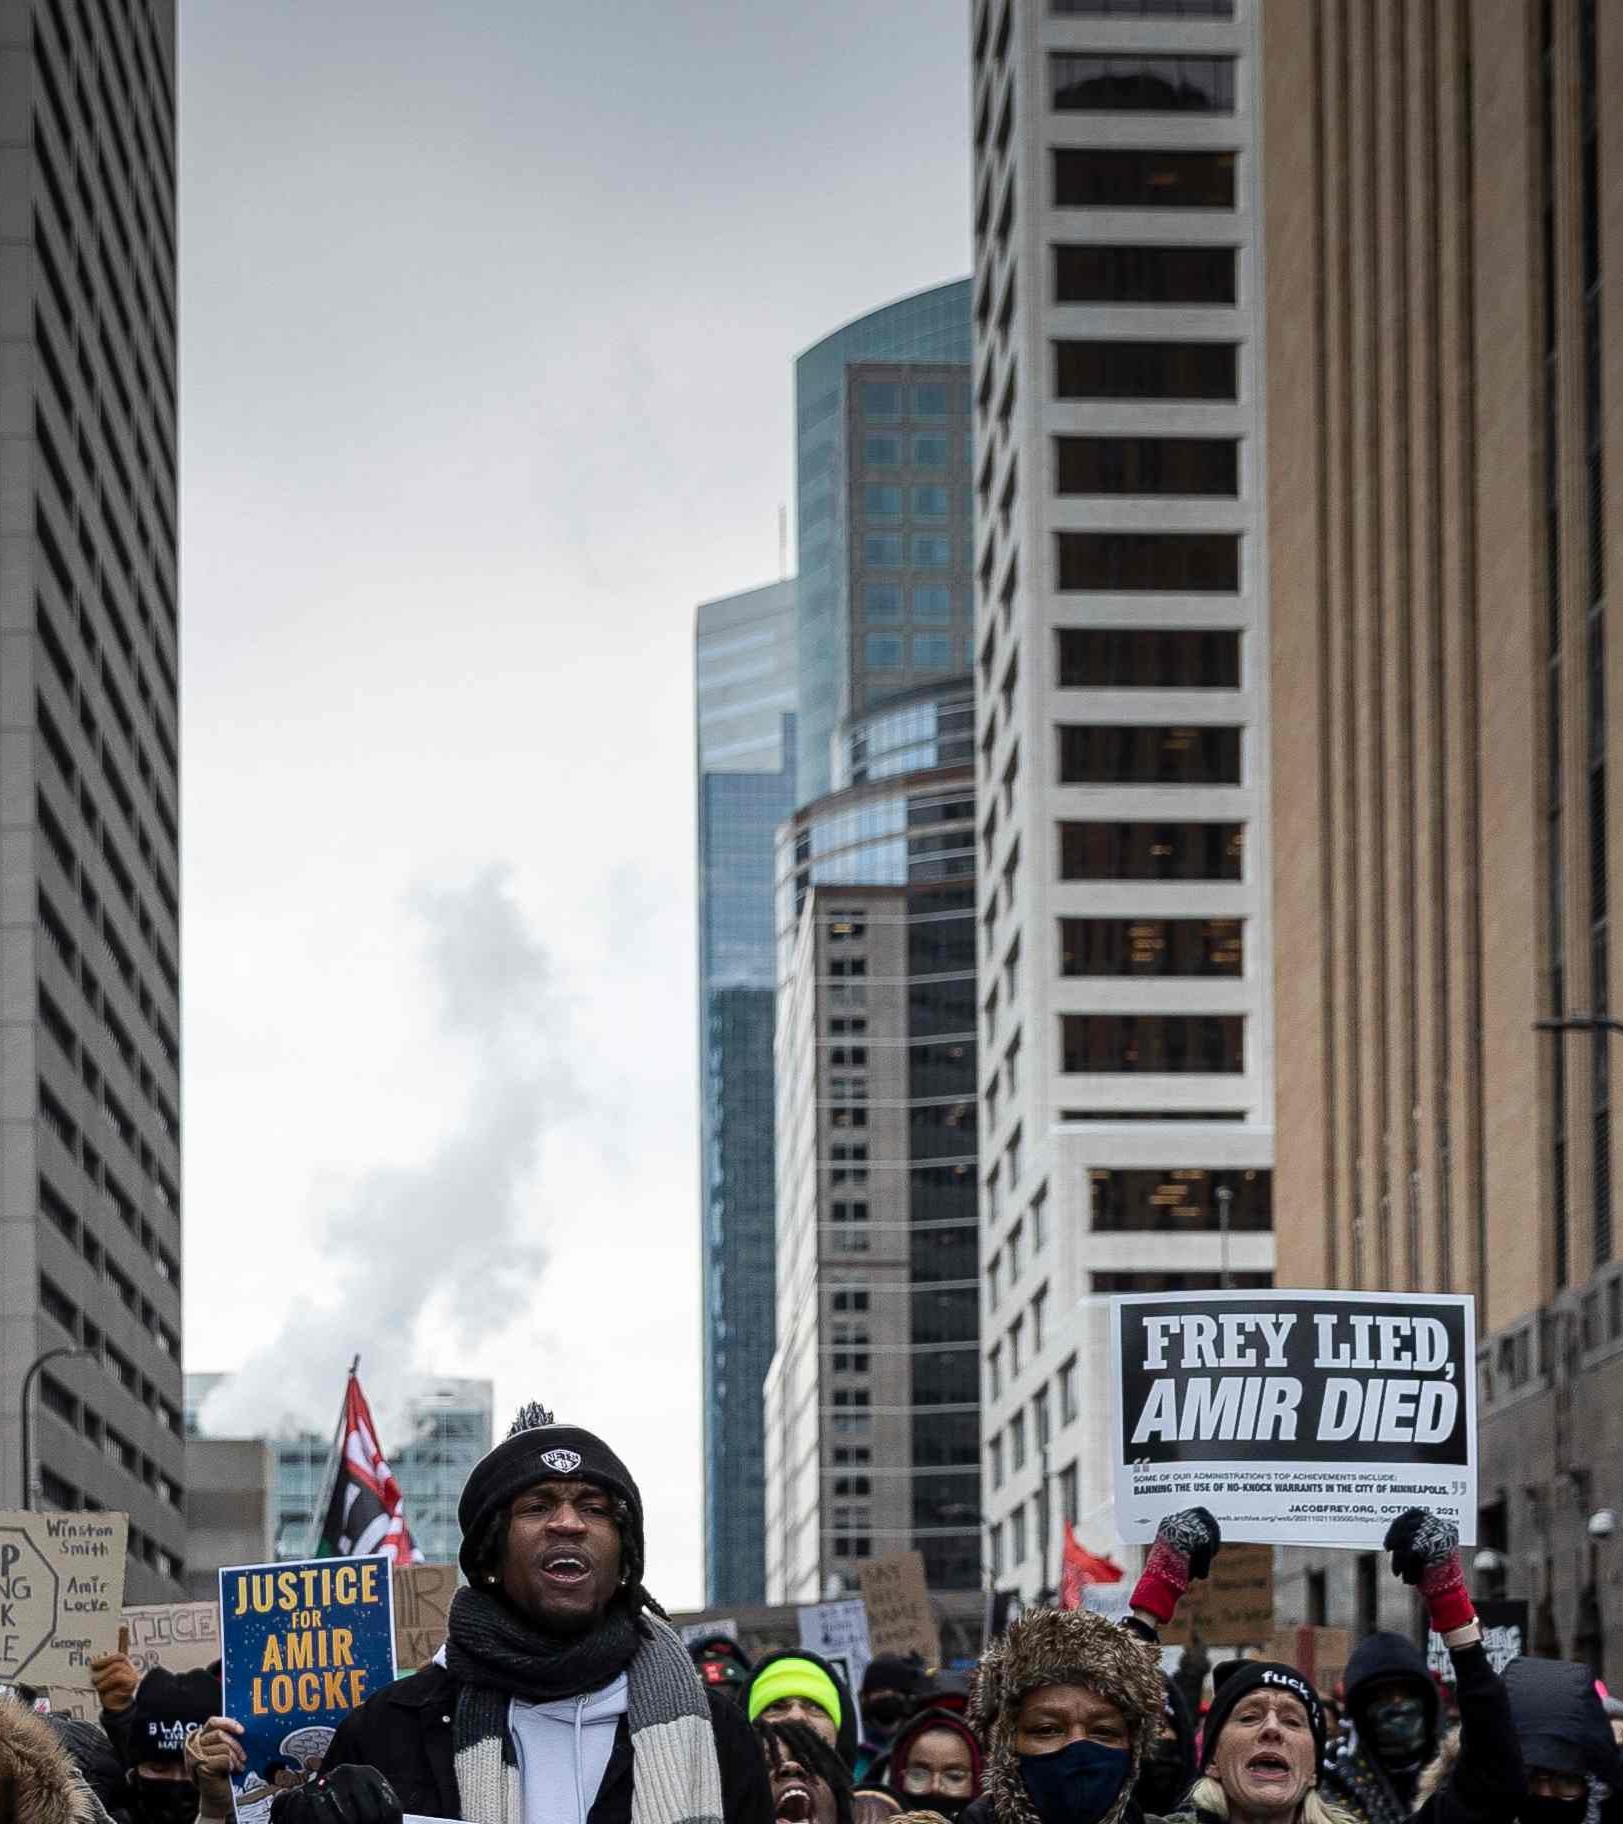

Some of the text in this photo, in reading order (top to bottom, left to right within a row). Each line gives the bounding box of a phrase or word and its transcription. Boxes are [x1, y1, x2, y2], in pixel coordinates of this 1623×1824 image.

[1142, 1313, 1455, 1381] FREY LIED,
[1130, 1376, 1459, 1445] AMIR DIED
[1133, 1474, 1157, 1483] SOME
[1159, 1474, 1170, 1482] OF
[1173, 1473, 1191, 1481] OUR
[1194, 1472, 1272, 1480] ADMINISTRATION'S
[1274, 1472, 1291, 1480] TOP
[1293, 1473, 1357, 1481] ACHIEVEMENTS
[1133, 1483, 1449, 1495] BANNING THE USE OF NO-KNOCK WARRANTS IN THE CITY OF MINNEAPOLIS.
[1289, 1504, 1377, 1514] JACOBFREY.ORG,
[1435, 1506, 1459, 1516] 2021
[46, 1518, 114, 1538] Winston
[59, 1539, 109, 1558] Smith
[66, 1575, 109, 1595] Amir
[235, 1564, 380, 1616] JUSTICE
[63, 1598, 110, 1614] Locke
[291, 1609, 322, 1629] FOR
[50, 1637, 92, 1650] George
[262, 1627, 354, 1673] AMIR
[252, 1669, 369, 1716] LOCKE
[1261, 1670, 1310, 1700] fuck
[148, 1720, 203, 1736] BLAC
